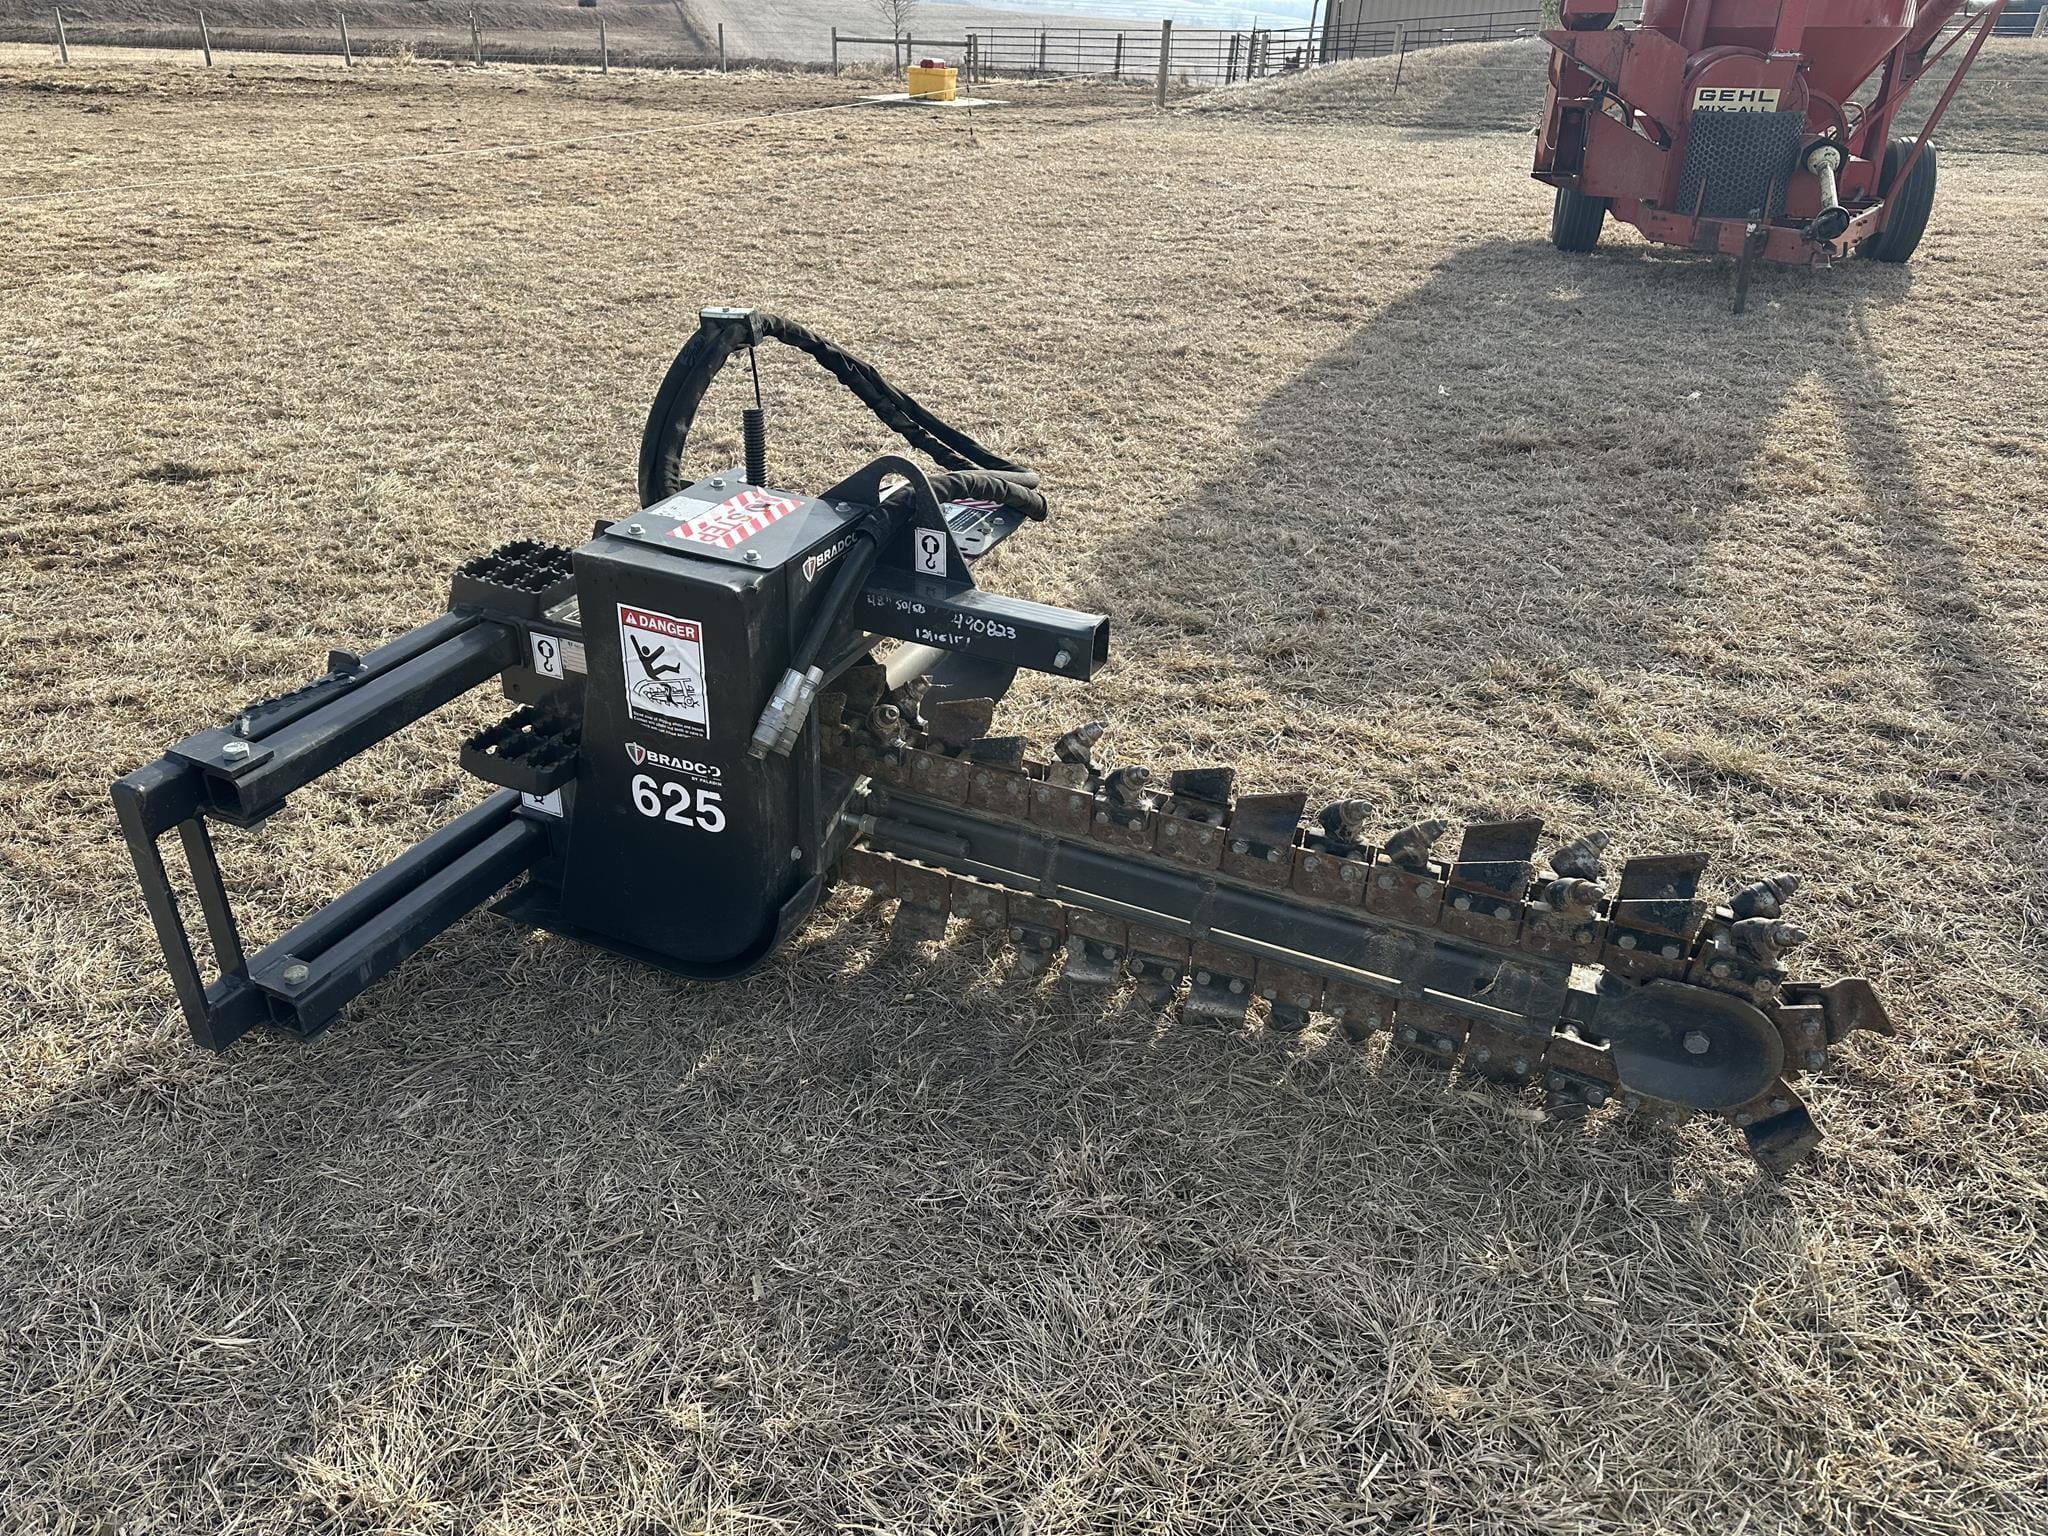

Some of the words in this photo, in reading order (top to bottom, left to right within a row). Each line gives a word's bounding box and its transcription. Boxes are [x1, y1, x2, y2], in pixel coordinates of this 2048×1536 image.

[1699, 89, 1774, 102] GEHL
[697, 512, 753, 542] STEP
[639, 615, 695, 639] DANGER
[647, 750, 721, 778] BRADCO
[632, 774, 726, 833] 625
